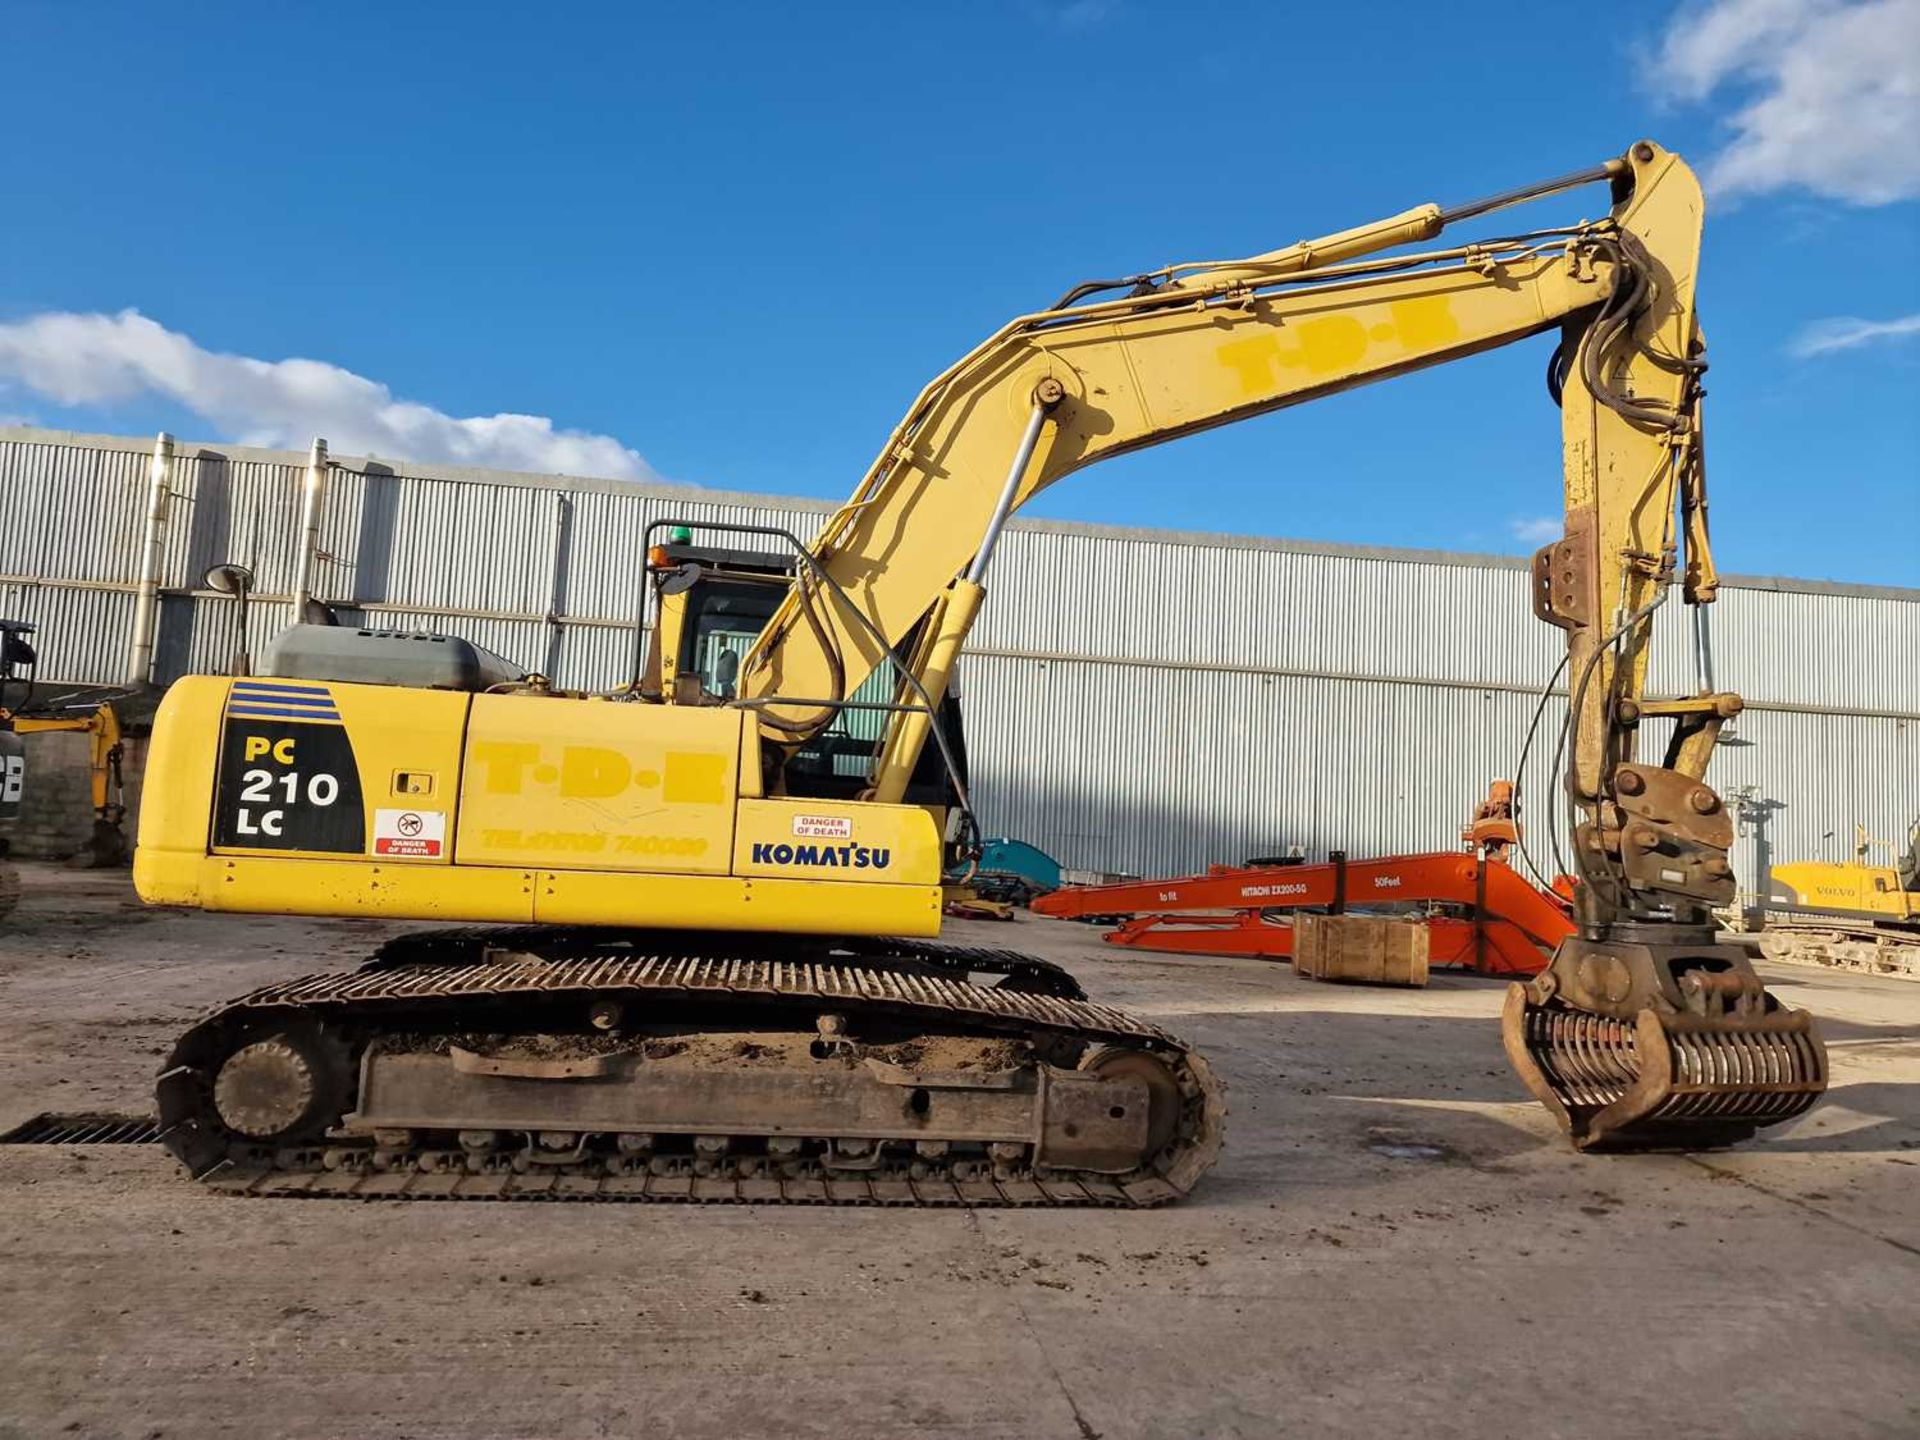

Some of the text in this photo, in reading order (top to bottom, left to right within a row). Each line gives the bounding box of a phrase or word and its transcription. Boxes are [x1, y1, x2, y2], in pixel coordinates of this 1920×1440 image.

[244, 736, 296, 765] PC
[240, 769, 339, 806] 210
[236, 808, 284, 836] LC
[802, 817, 844, 827] DANGER
[797, 826, 847, 836] OF DEATH
[391, 840, 427, 848] DANGER
[401, 847, 430, 855] DEATH
[752, 842, 890, 869] KOMATSU
[1241, 886, 1270, 897] HITACHI
[1816, 885, 1856, 897] VOLVO
